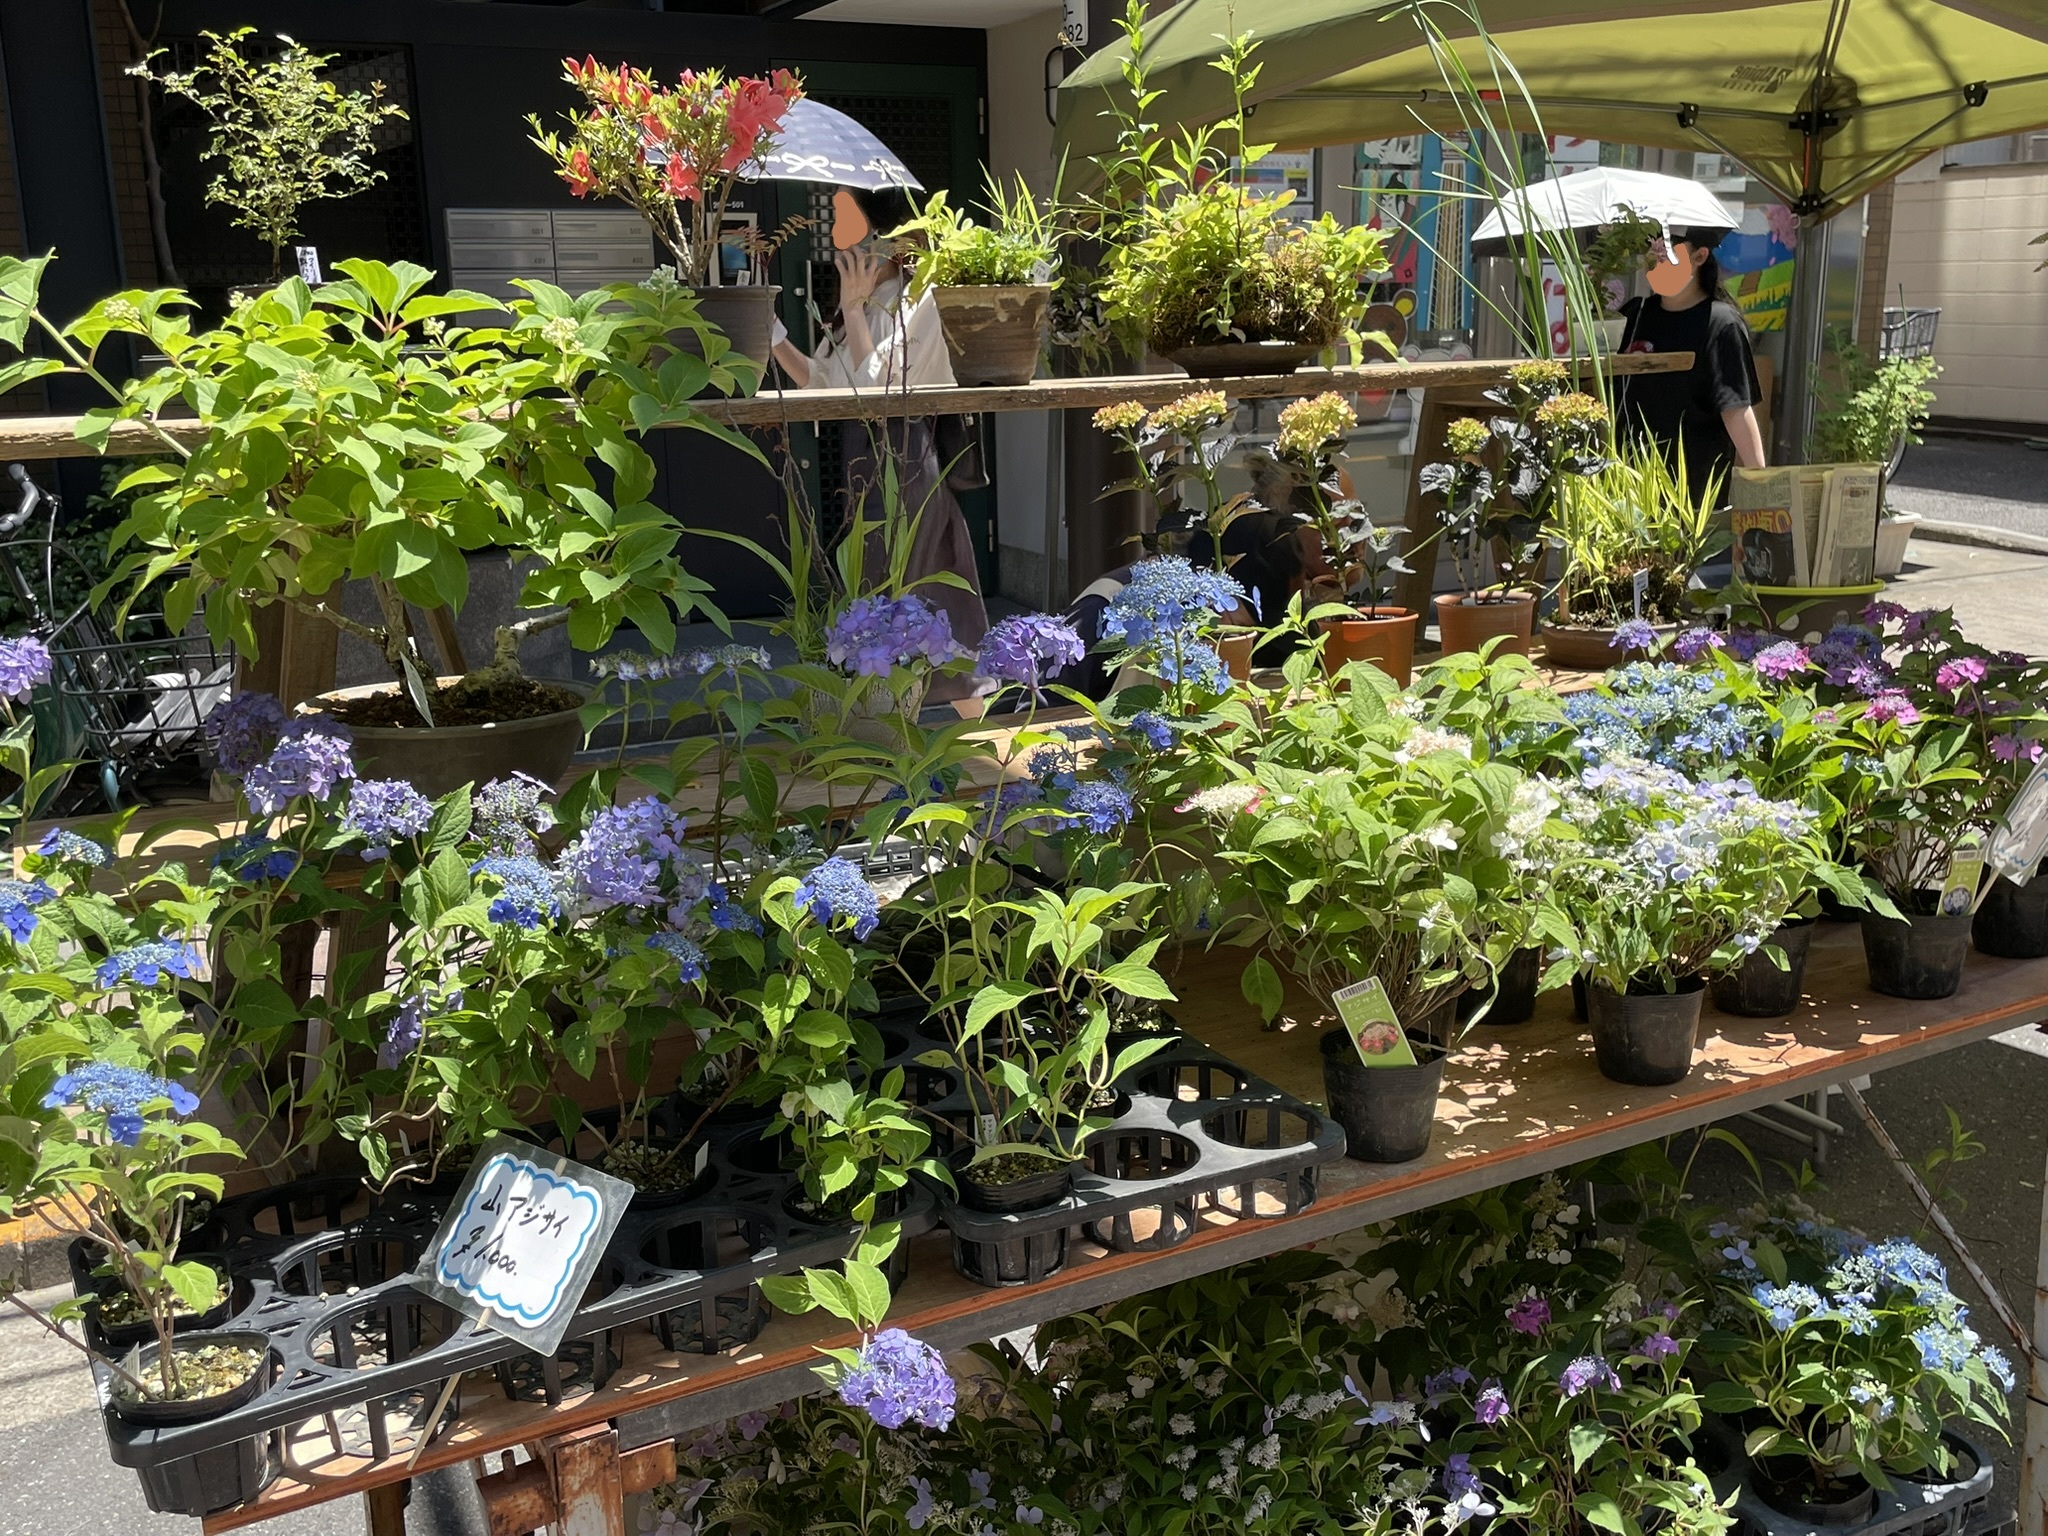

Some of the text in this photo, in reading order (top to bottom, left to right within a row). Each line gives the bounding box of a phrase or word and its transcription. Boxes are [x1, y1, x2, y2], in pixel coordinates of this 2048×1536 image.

[1063, 23, 1083, 42] 82
[1345, 993, 1379, 1011] アジサイ
